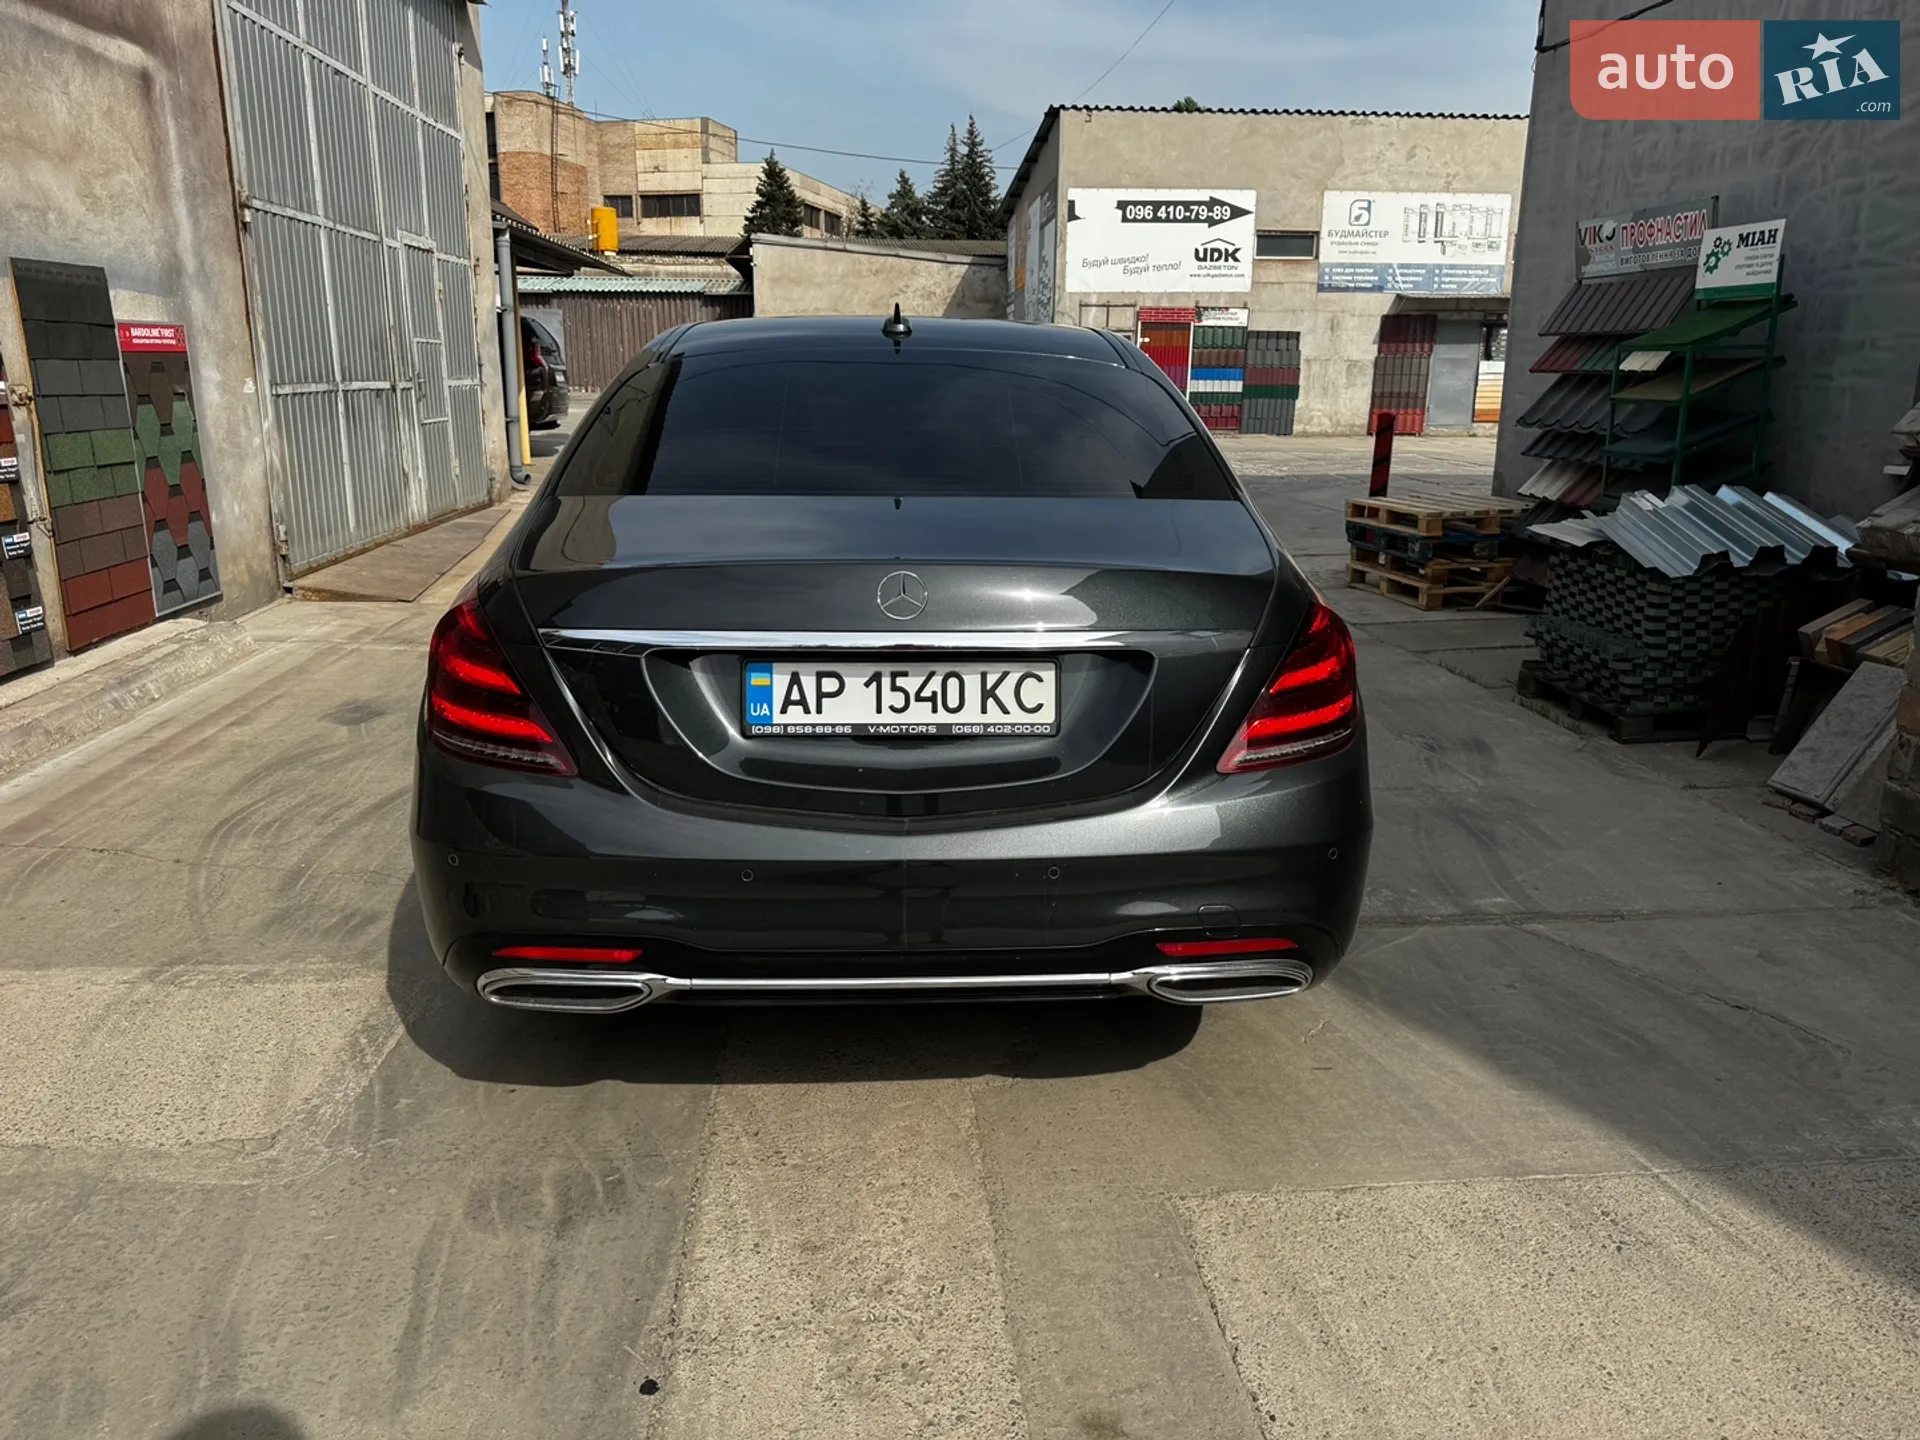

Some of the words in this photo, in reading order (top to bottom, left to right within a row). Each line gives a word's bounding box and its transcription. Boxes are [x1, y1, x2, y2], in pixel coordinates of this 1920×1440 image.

[1126, 205, 1154, 220] 096
[1157, 205, 1231, 220] 410-79-89
[1327, 228, 1389, 239] БУДМАЙСТЕР
[1620, 209, 1708, 250] ПРОФНАСТИЛ
[1081, 257, 1110, 270] Будуй
[1110, 254, 1150, 266] швидко!
[1194, 247, 1243, 262] UDK
[1620, 250, 1674, 267] ВИГОТОВЛЕННЯ
[1122, 262, 1151, 276] Будуй
[1152, 261, 1182, 272] тепло!
[779, 670, 846, 715] AP
[863, 670, 966, 714] 1540
[980, 670, 1045, 715] KC
[750, 702, 771, 717] UA
[751, 725, 784, 735] (098)
[787, 725, 853, 734] 858-88-86
[868, 725, 937, 734] V-MOTORS
[952, 724, 984, 735] (068)
[986, 725, 1051, 734] 402-00-00
